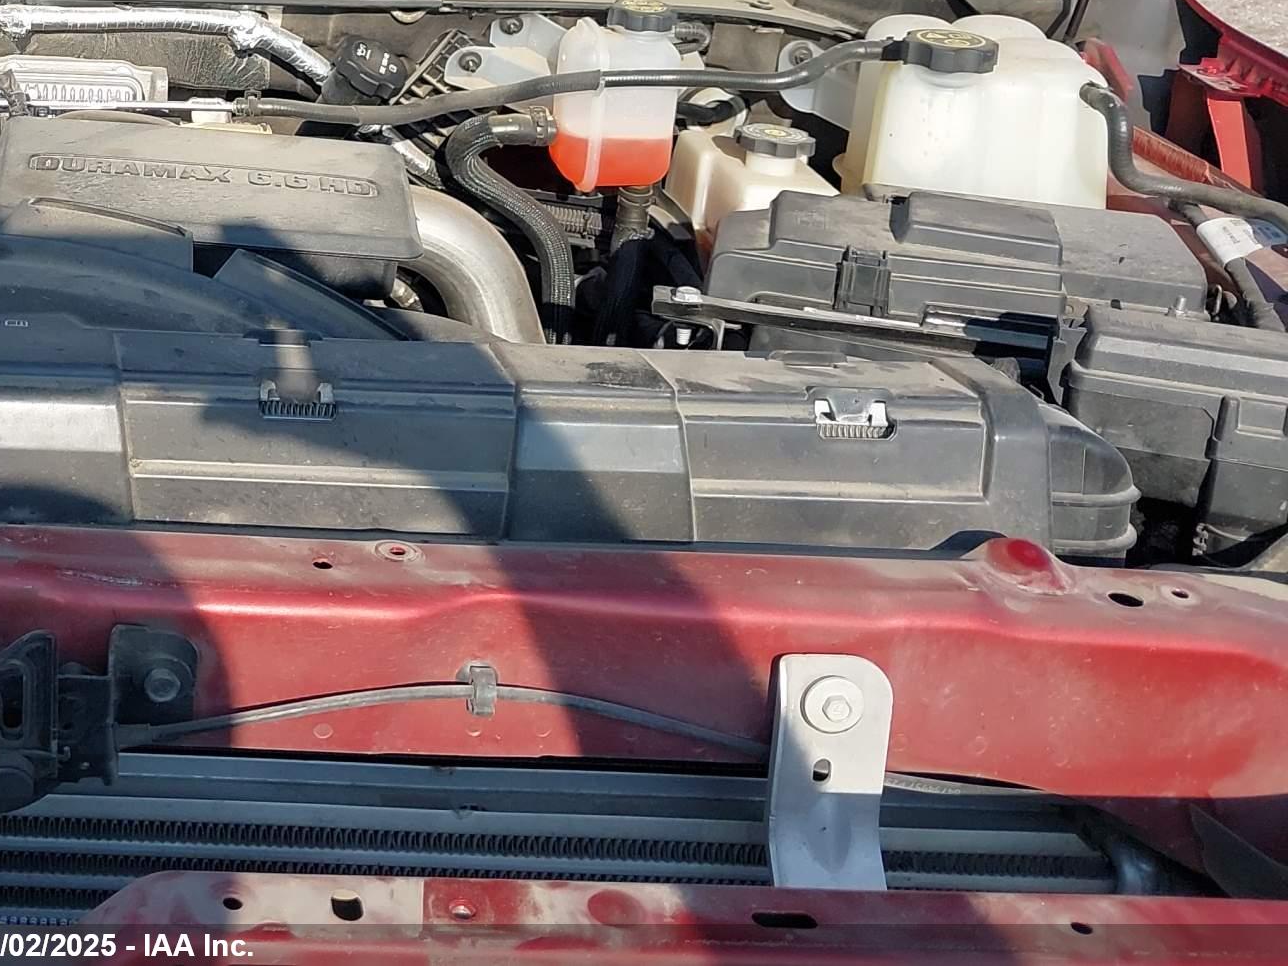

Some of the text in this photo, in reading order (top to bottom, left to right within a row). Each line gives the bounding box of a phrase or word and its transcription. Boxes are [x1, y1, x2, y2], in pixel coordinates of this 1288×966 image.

[35, 155, 375, 197] DURAMAX 6.6 HD
